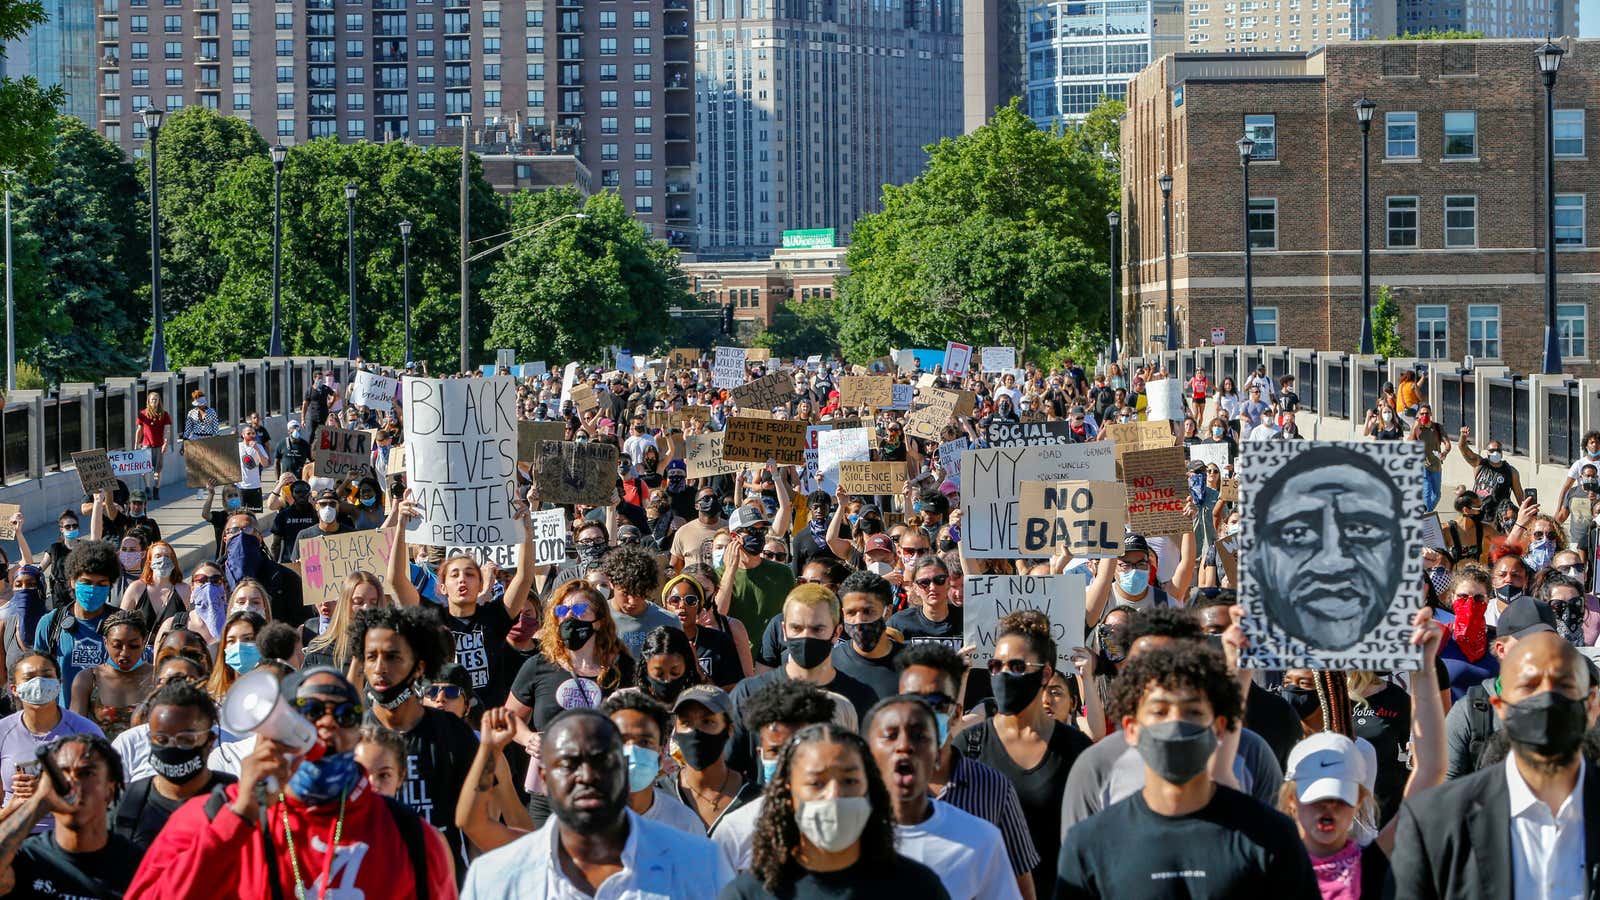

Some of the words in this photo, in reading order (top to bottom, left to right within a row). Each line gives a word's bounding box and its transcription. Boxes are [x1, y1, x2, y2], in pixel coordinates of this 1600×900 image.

[932, 389, 946, 399] THE
[412, 380, 514, 436] BLACK
[728, 420, 764, 431] WHITE
[766, 422, 801, 433] PEOPLE
[988, 422, 1054, 442] SOCIAL
[727, 431, 747, 440] IT'S
[750, 432, 773, 444] TIME
[776, 436, 797, 447] YOU
[724, 444, 749, 457] JOIN
[752, 448, 773, 459] THE
[775, 449, 805, 463] FIGHT
[1042, 449, 1062, 459] DAD
[1241, 441, 1315, 453] JUSTICE
[123, 452, 134, 461] TO
[411, 438, 516, 485] LIVES
[697, 456, 723, 469] MUST
[118, 460, 152, 472] AMERICA
[717, 462, 749, 474] POLICE
[841, 464, 871, 473] WHITE
[1061, 462, 1090, 470] UNCLES
[895, 471, 905, 482] IS
[973, 448, 1026, 499] MY
[844, 483, 892, 493] VIOLENCE
[1133, 475, 1154, 488] NO
[408, 479, 519, 523] MATTER
[1043, 486, 1094, 514] NO
[1133, 487, 1175, 501] JUSTICE
[432, 523, 504, 544] PERIOD.
[541, 523, 560, 538] for
[1024, 516, 1119, 551] BAIL
[328, 535, 376, 562] BLACK
[331, 558, 377, 578] LIVES
[968, 575, 999, 596] IF
[1009, 575, 1055, 596] NOT
[995, 597, 1052, 621] NOW
[73, 656, 102, 665] HERO
[1321, 657, 1405, 670] JUSTICE
